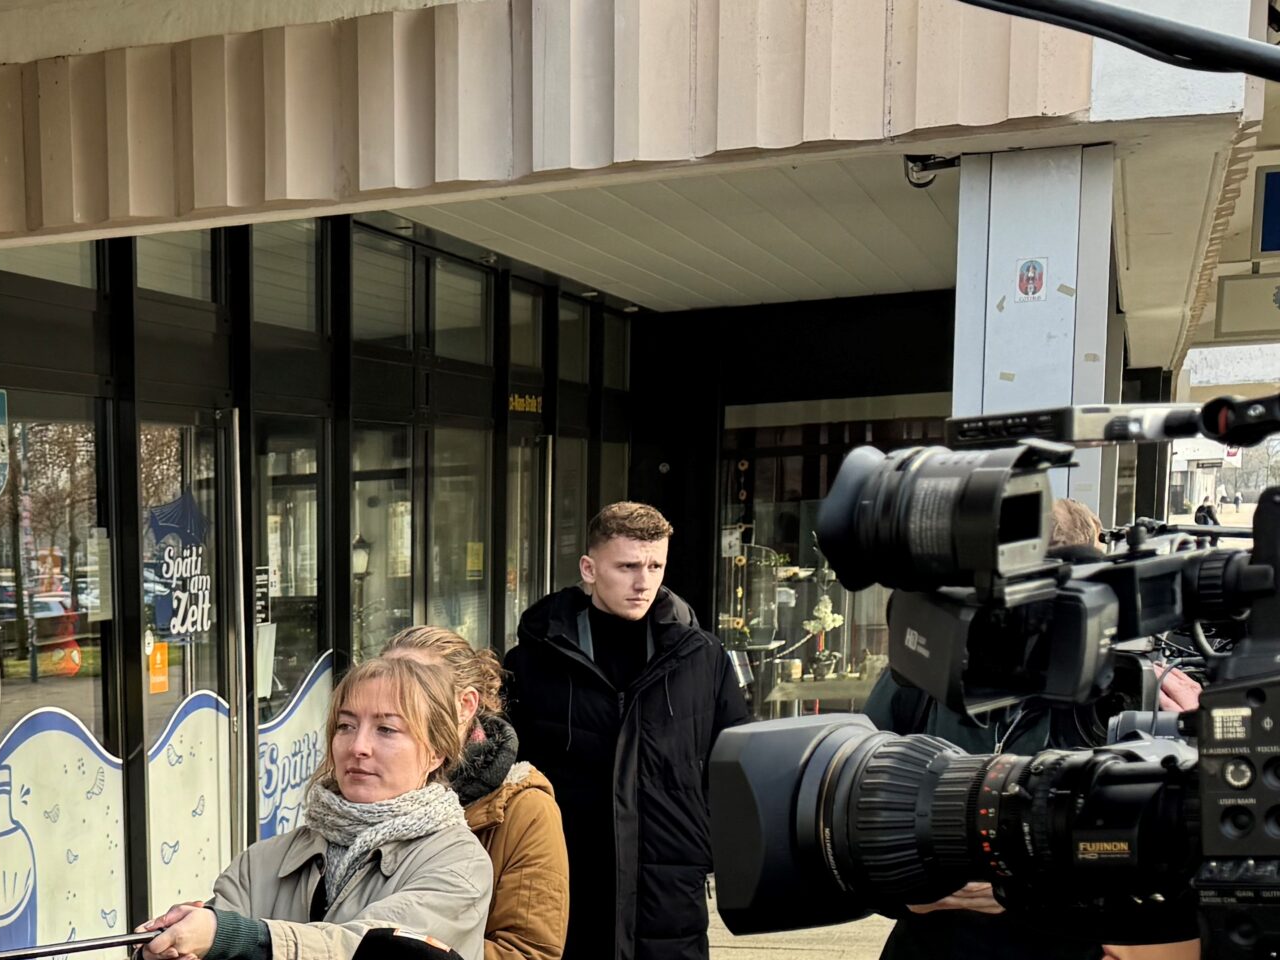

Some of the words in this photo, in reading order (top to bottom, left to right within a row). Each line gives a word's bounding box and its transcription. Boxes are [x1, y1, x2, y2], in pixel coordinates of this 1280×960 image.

[162, 545, 203, 588] Späti
[190, 575, 211, 594] am
[170, 588, 211, 634] Zelt
[1079, 842, 1129, 851] FUJINON
